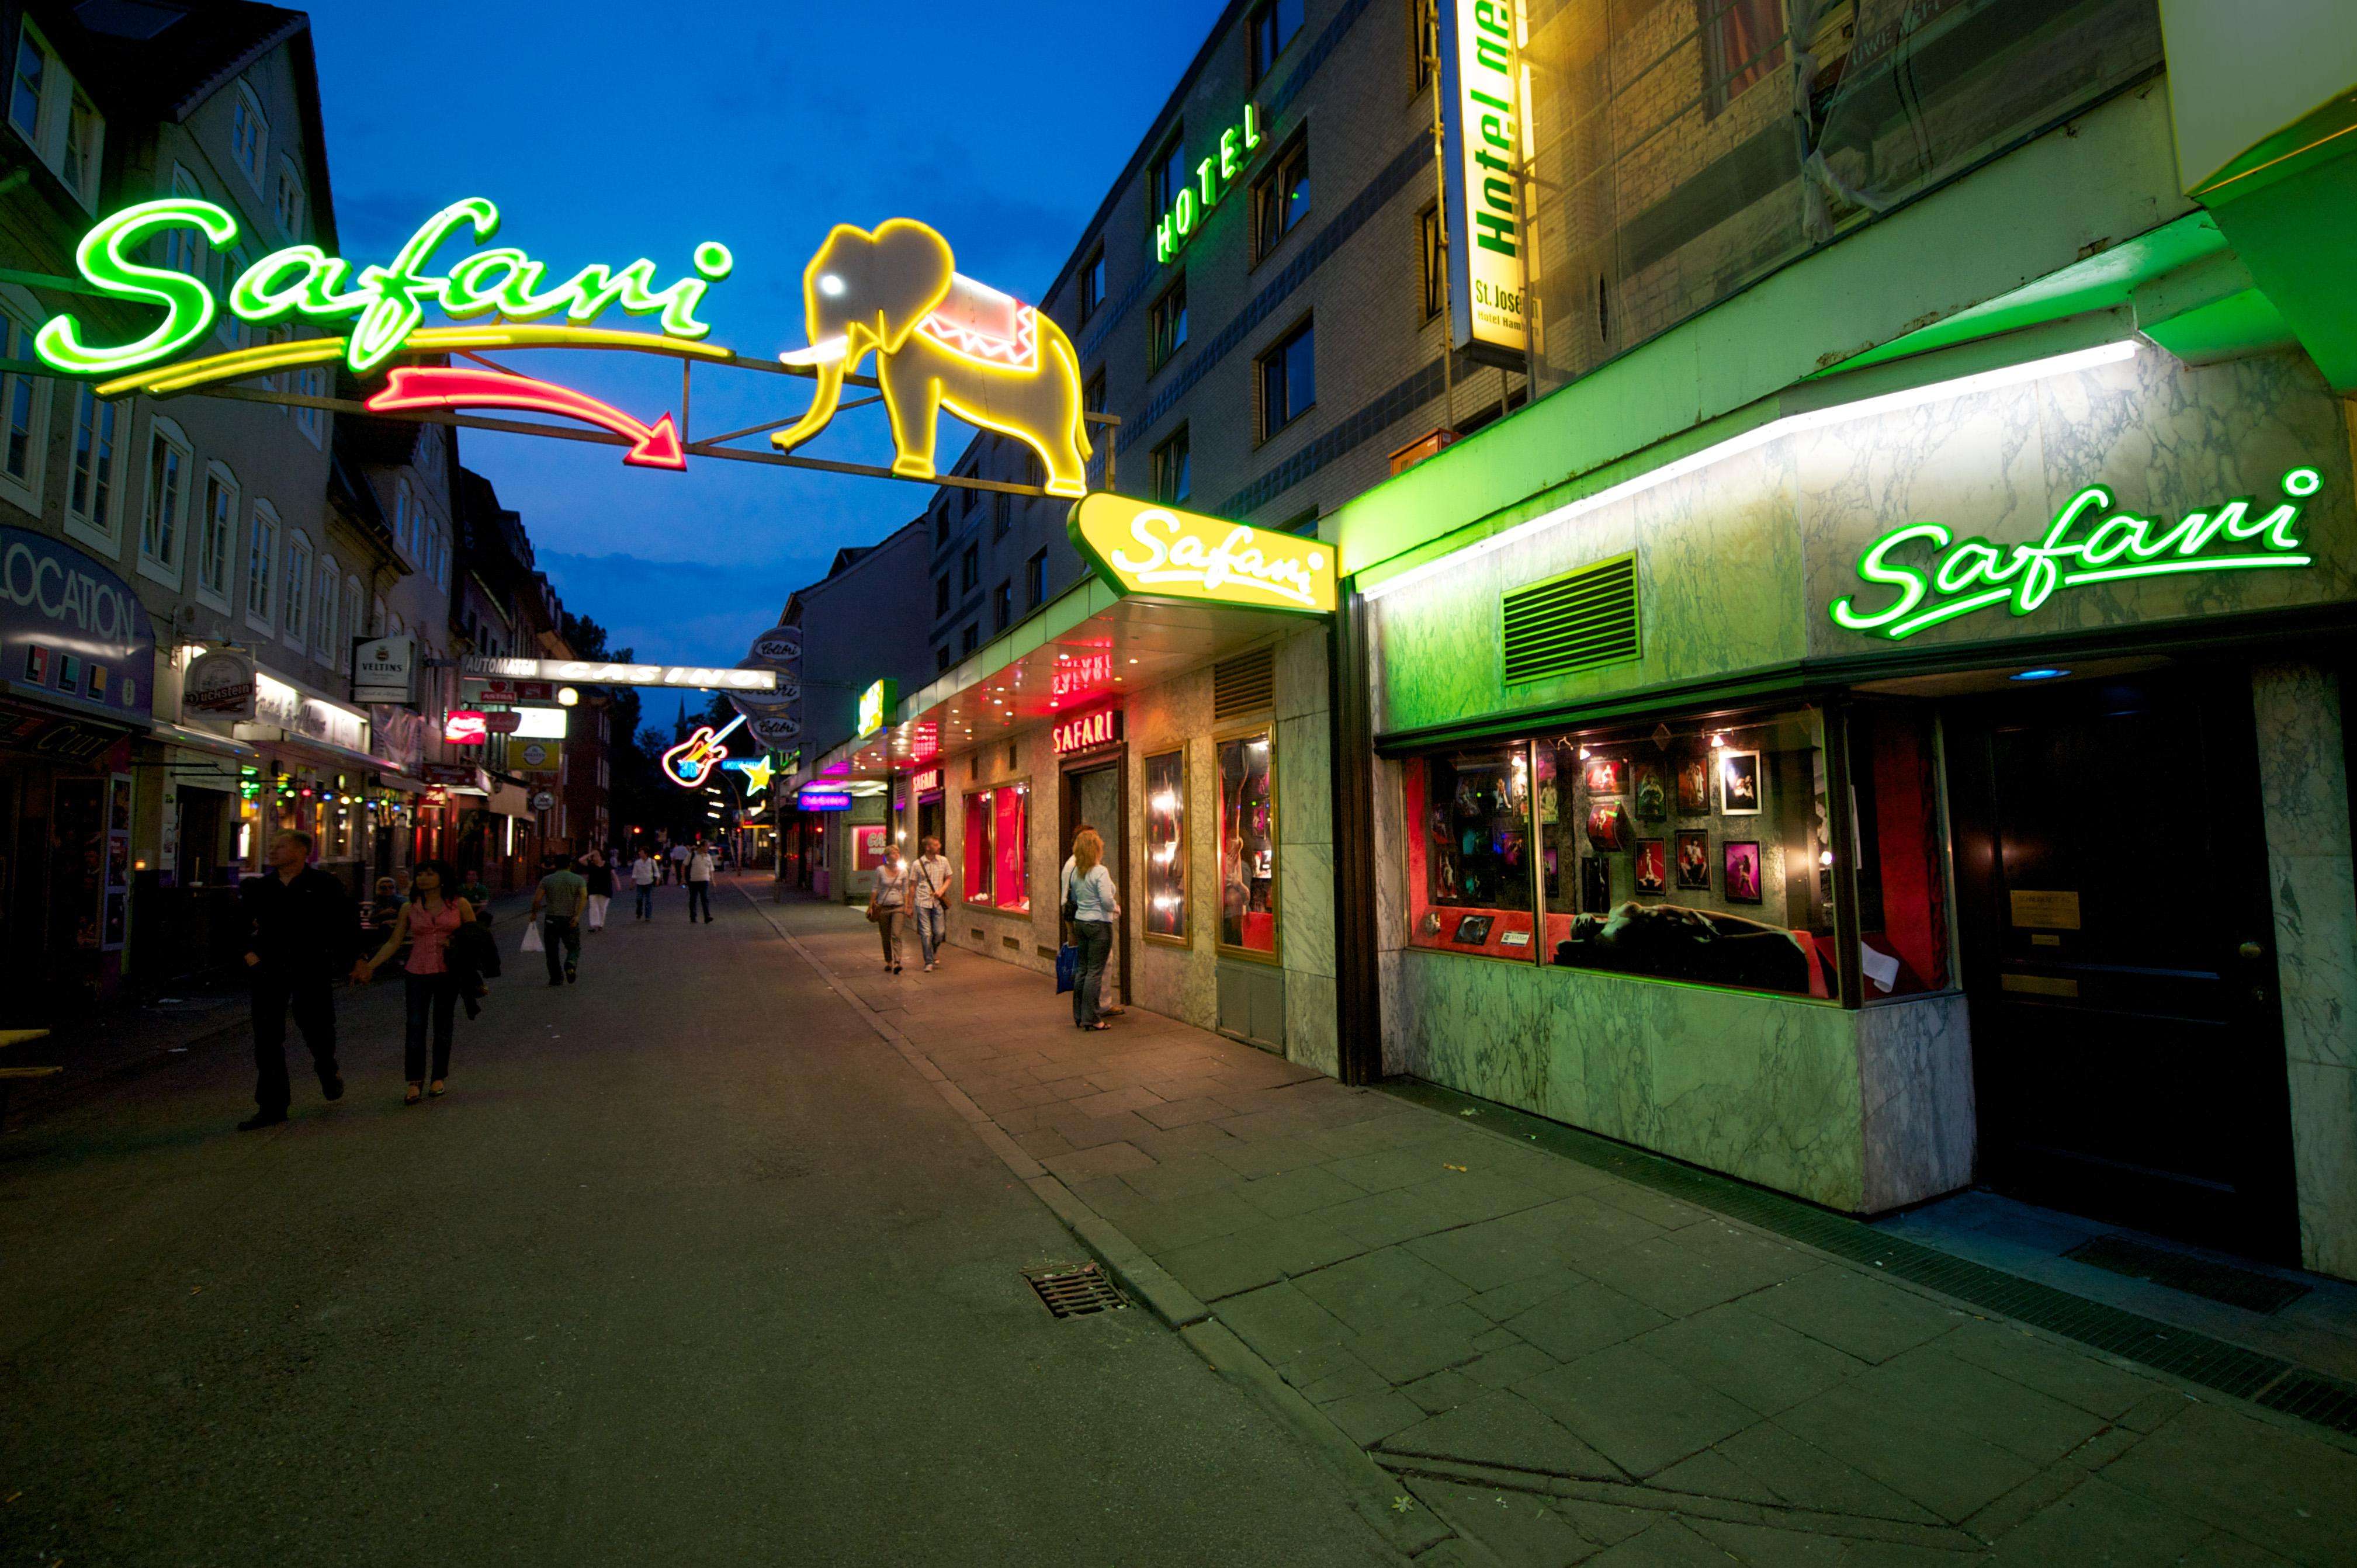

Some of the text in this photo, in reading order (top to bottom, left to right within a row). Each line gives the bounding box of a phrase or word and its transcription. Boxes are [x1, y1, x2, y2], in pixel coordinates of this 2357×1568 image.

[1156, 103, 1261, 263] HOTEL
[1470, 88, 1520, 259] Hotel
[34, 196, 734, 374] Safari
[1475, 279, 1539, 319] St. Jose
[1478, 310, 1500, 326] Hotel
[1110, 508, 1325, 595] Safari
[1828, 465, 2325, 632] Safari
[362, 662, 403, 672] VELTINS
[466, 657, 538, 676] AUTOMATEN
[761, 645, 798, 657] Colibri
[557, 661, 760, 687] CASINO
[1053, 710, 1113, 754] SAFARI
[867, 831, 886, 847] CA
